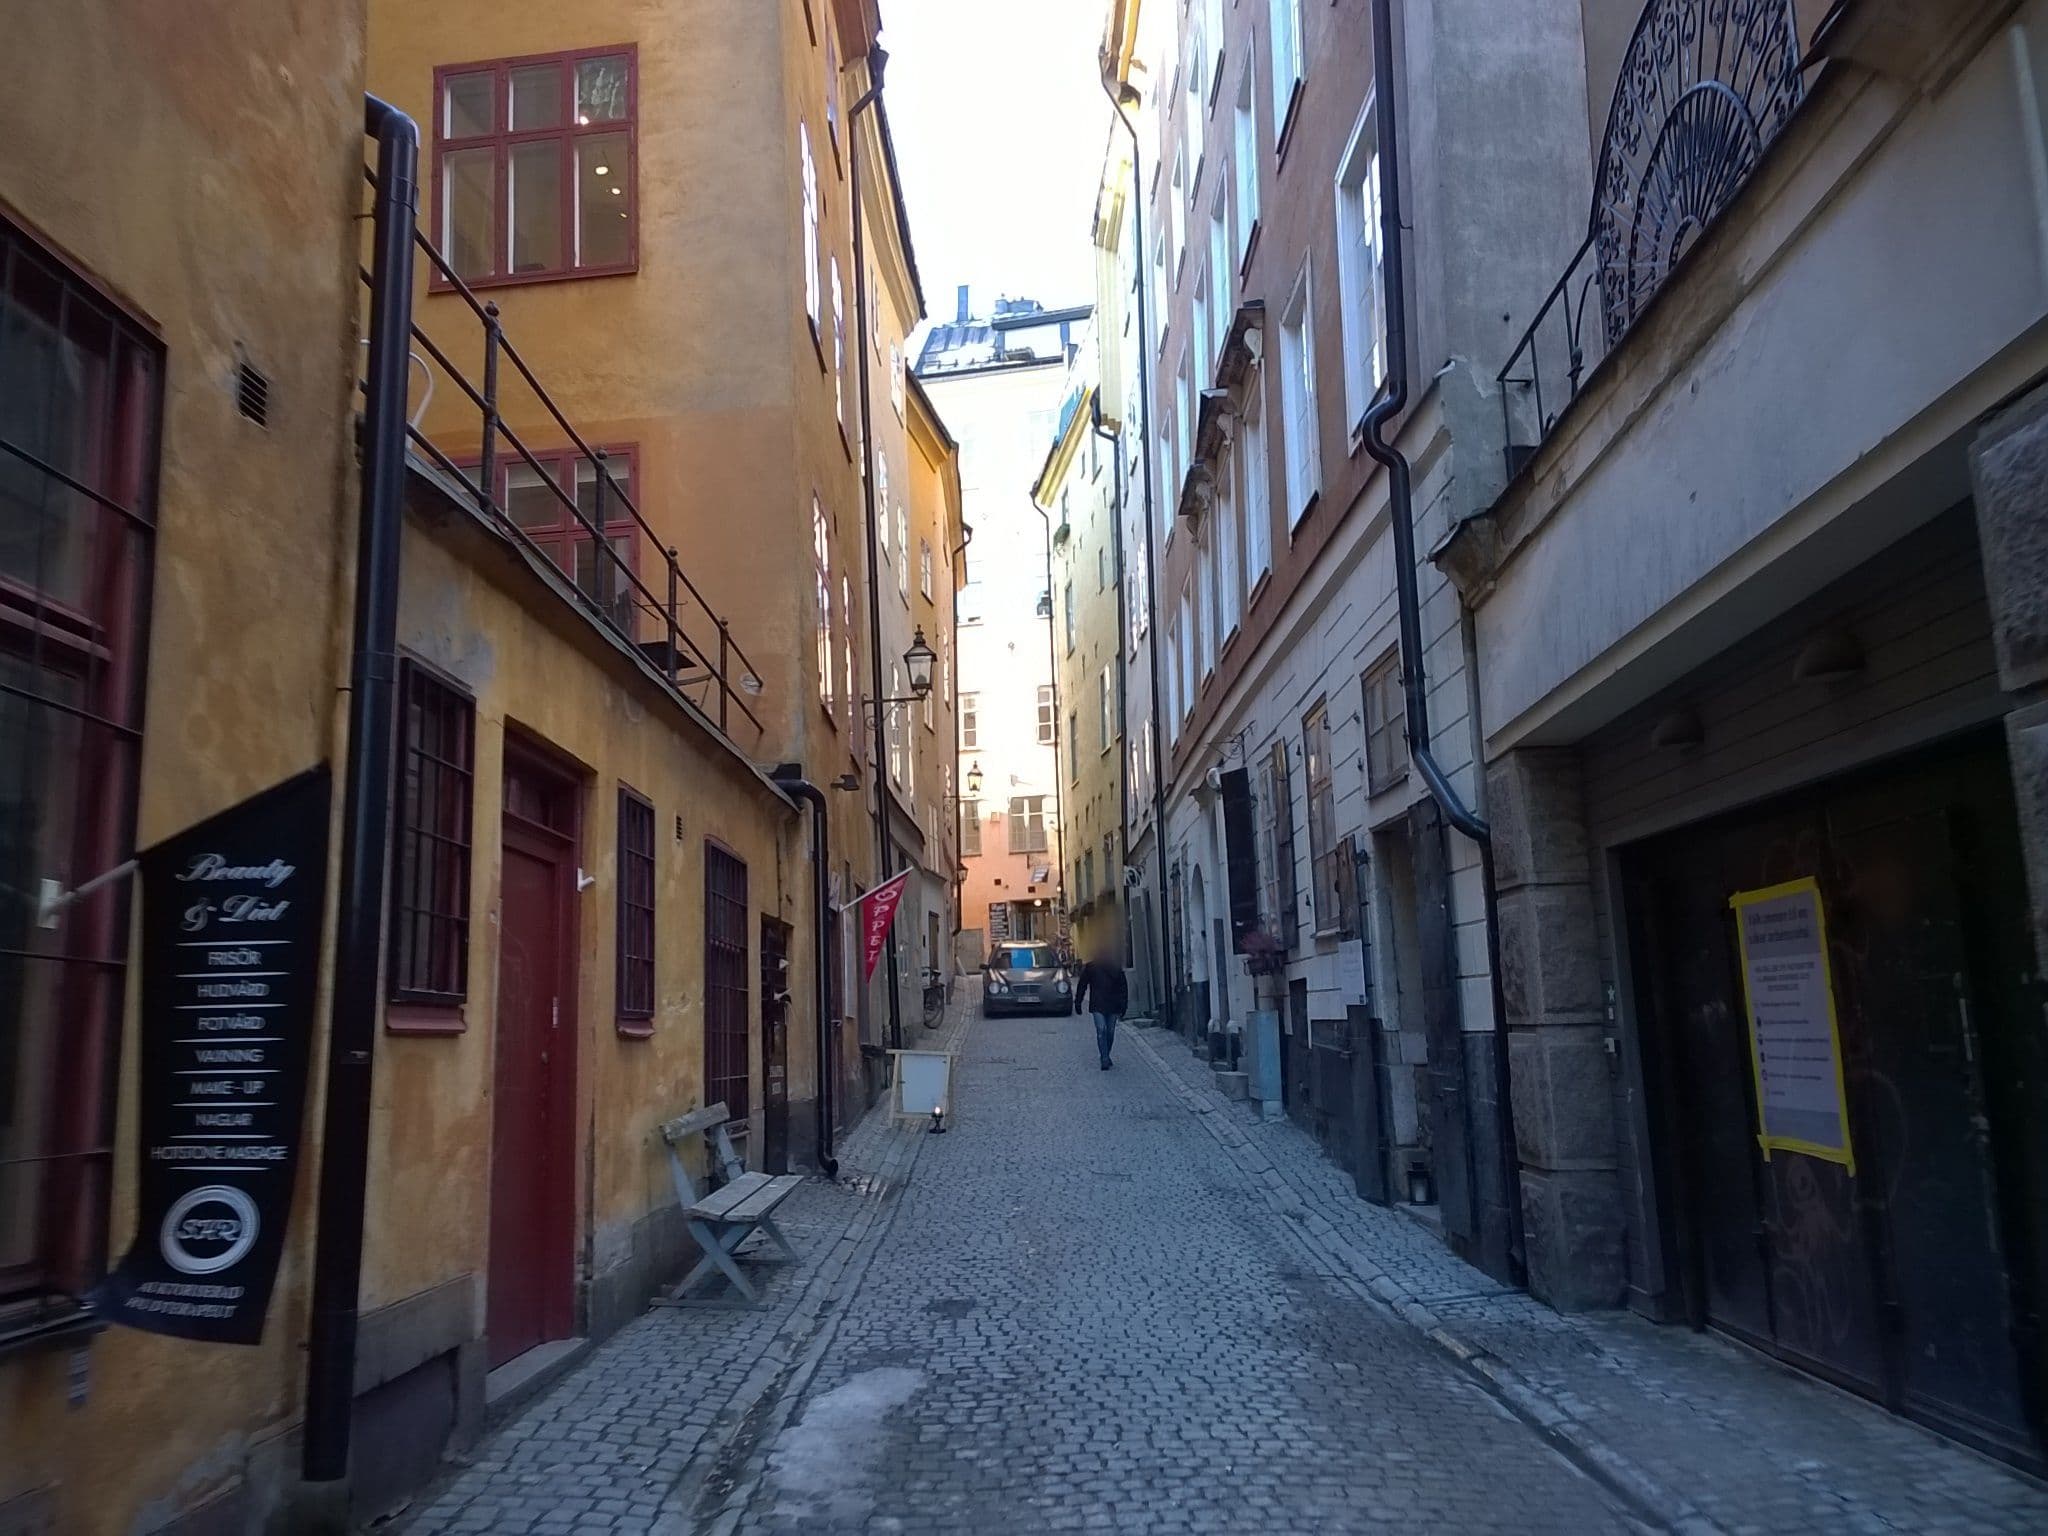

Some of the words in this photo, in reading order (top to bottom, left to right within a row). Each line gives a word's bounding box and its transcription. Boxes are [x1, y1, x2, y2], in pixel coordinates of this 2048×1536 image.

[175, 853, 296, 888] Beauty
[208, 948, 262, 966] FRISÖR
[197, 980, 270, 998] HUDVÅRD
[198, 1013, 266, 1030] FOTVÅRD
[190, 1080, 265, 1095] MAKE-UP
